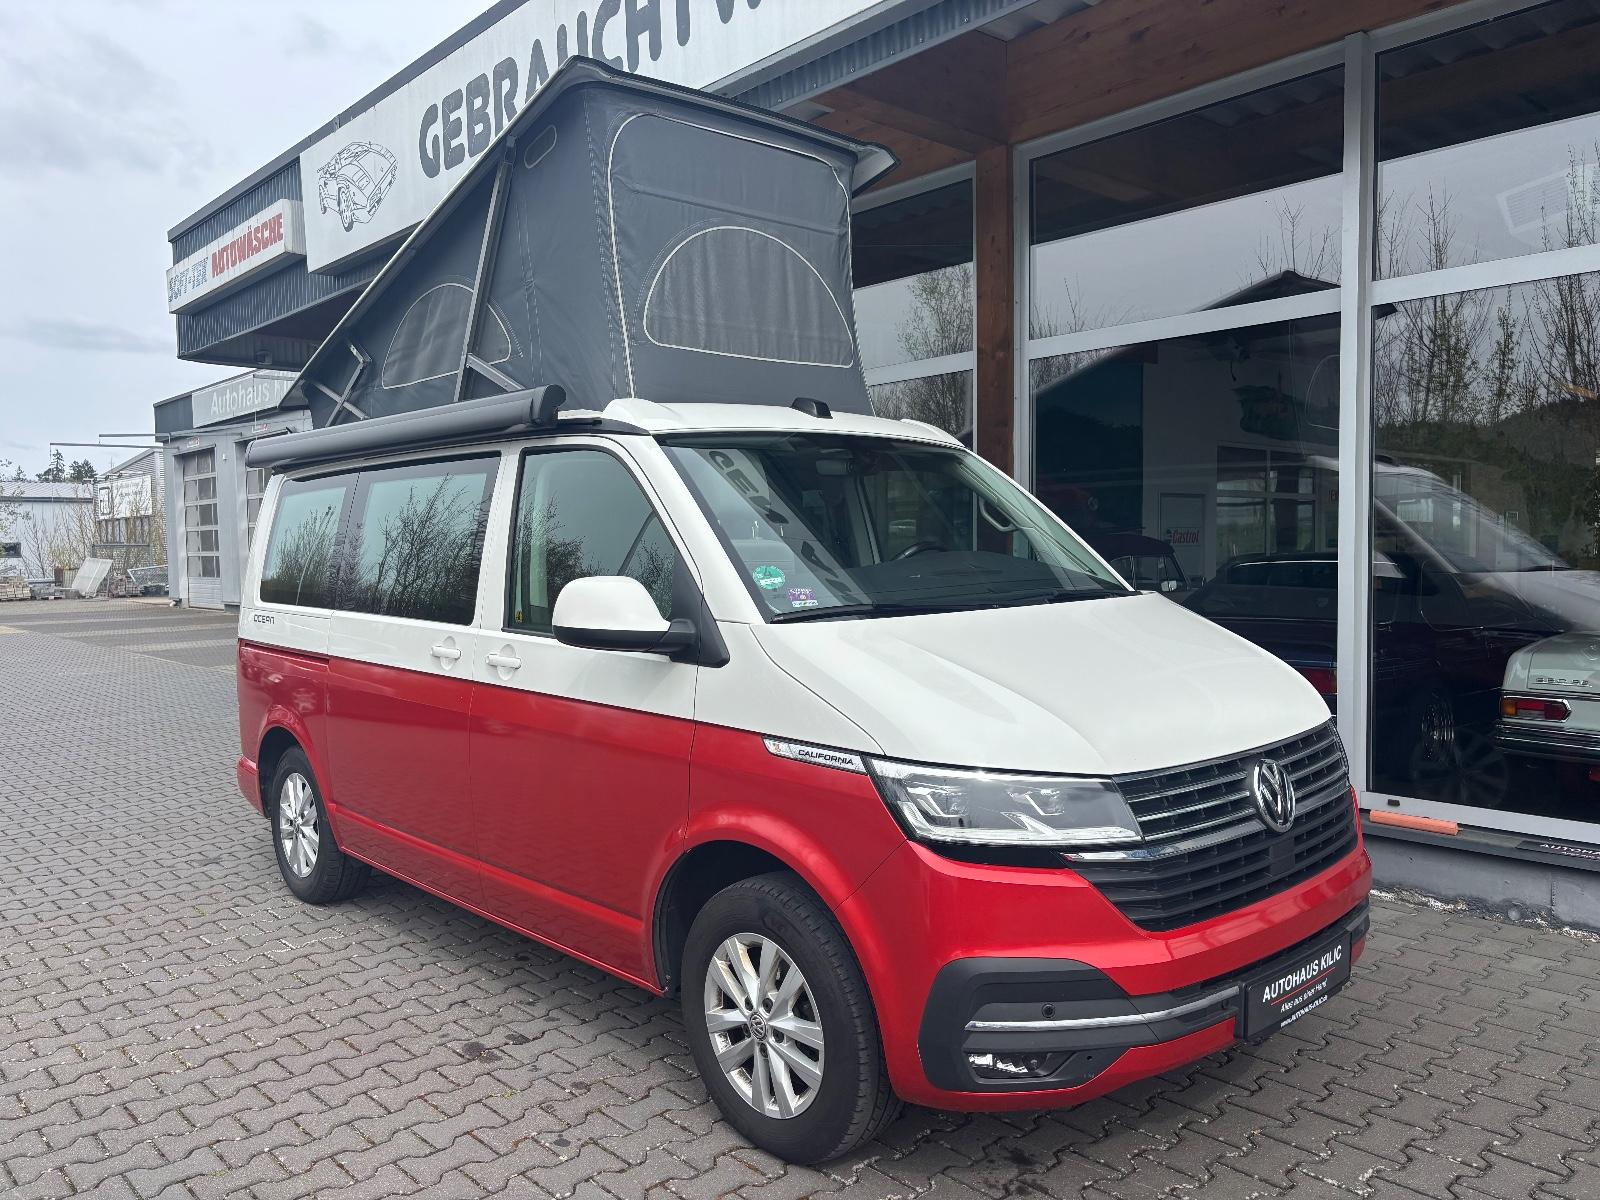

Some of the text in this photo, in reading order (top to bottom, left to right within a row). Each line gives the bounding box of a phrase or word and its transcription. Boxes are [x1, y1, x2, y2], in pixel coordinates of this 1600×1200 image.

[419, 0, 761, 178] GEBRAUCH
[212, 213, 284, 278] AUTOWÄSCHE
[211, 382, 269, 417] Autohaus
[1172, 529, 1200, 544] Castrol
[798, 748, 854, 766] CALIFORNIA
[1262, 944, 1342, 1003] AUTOHAUS KILIC
